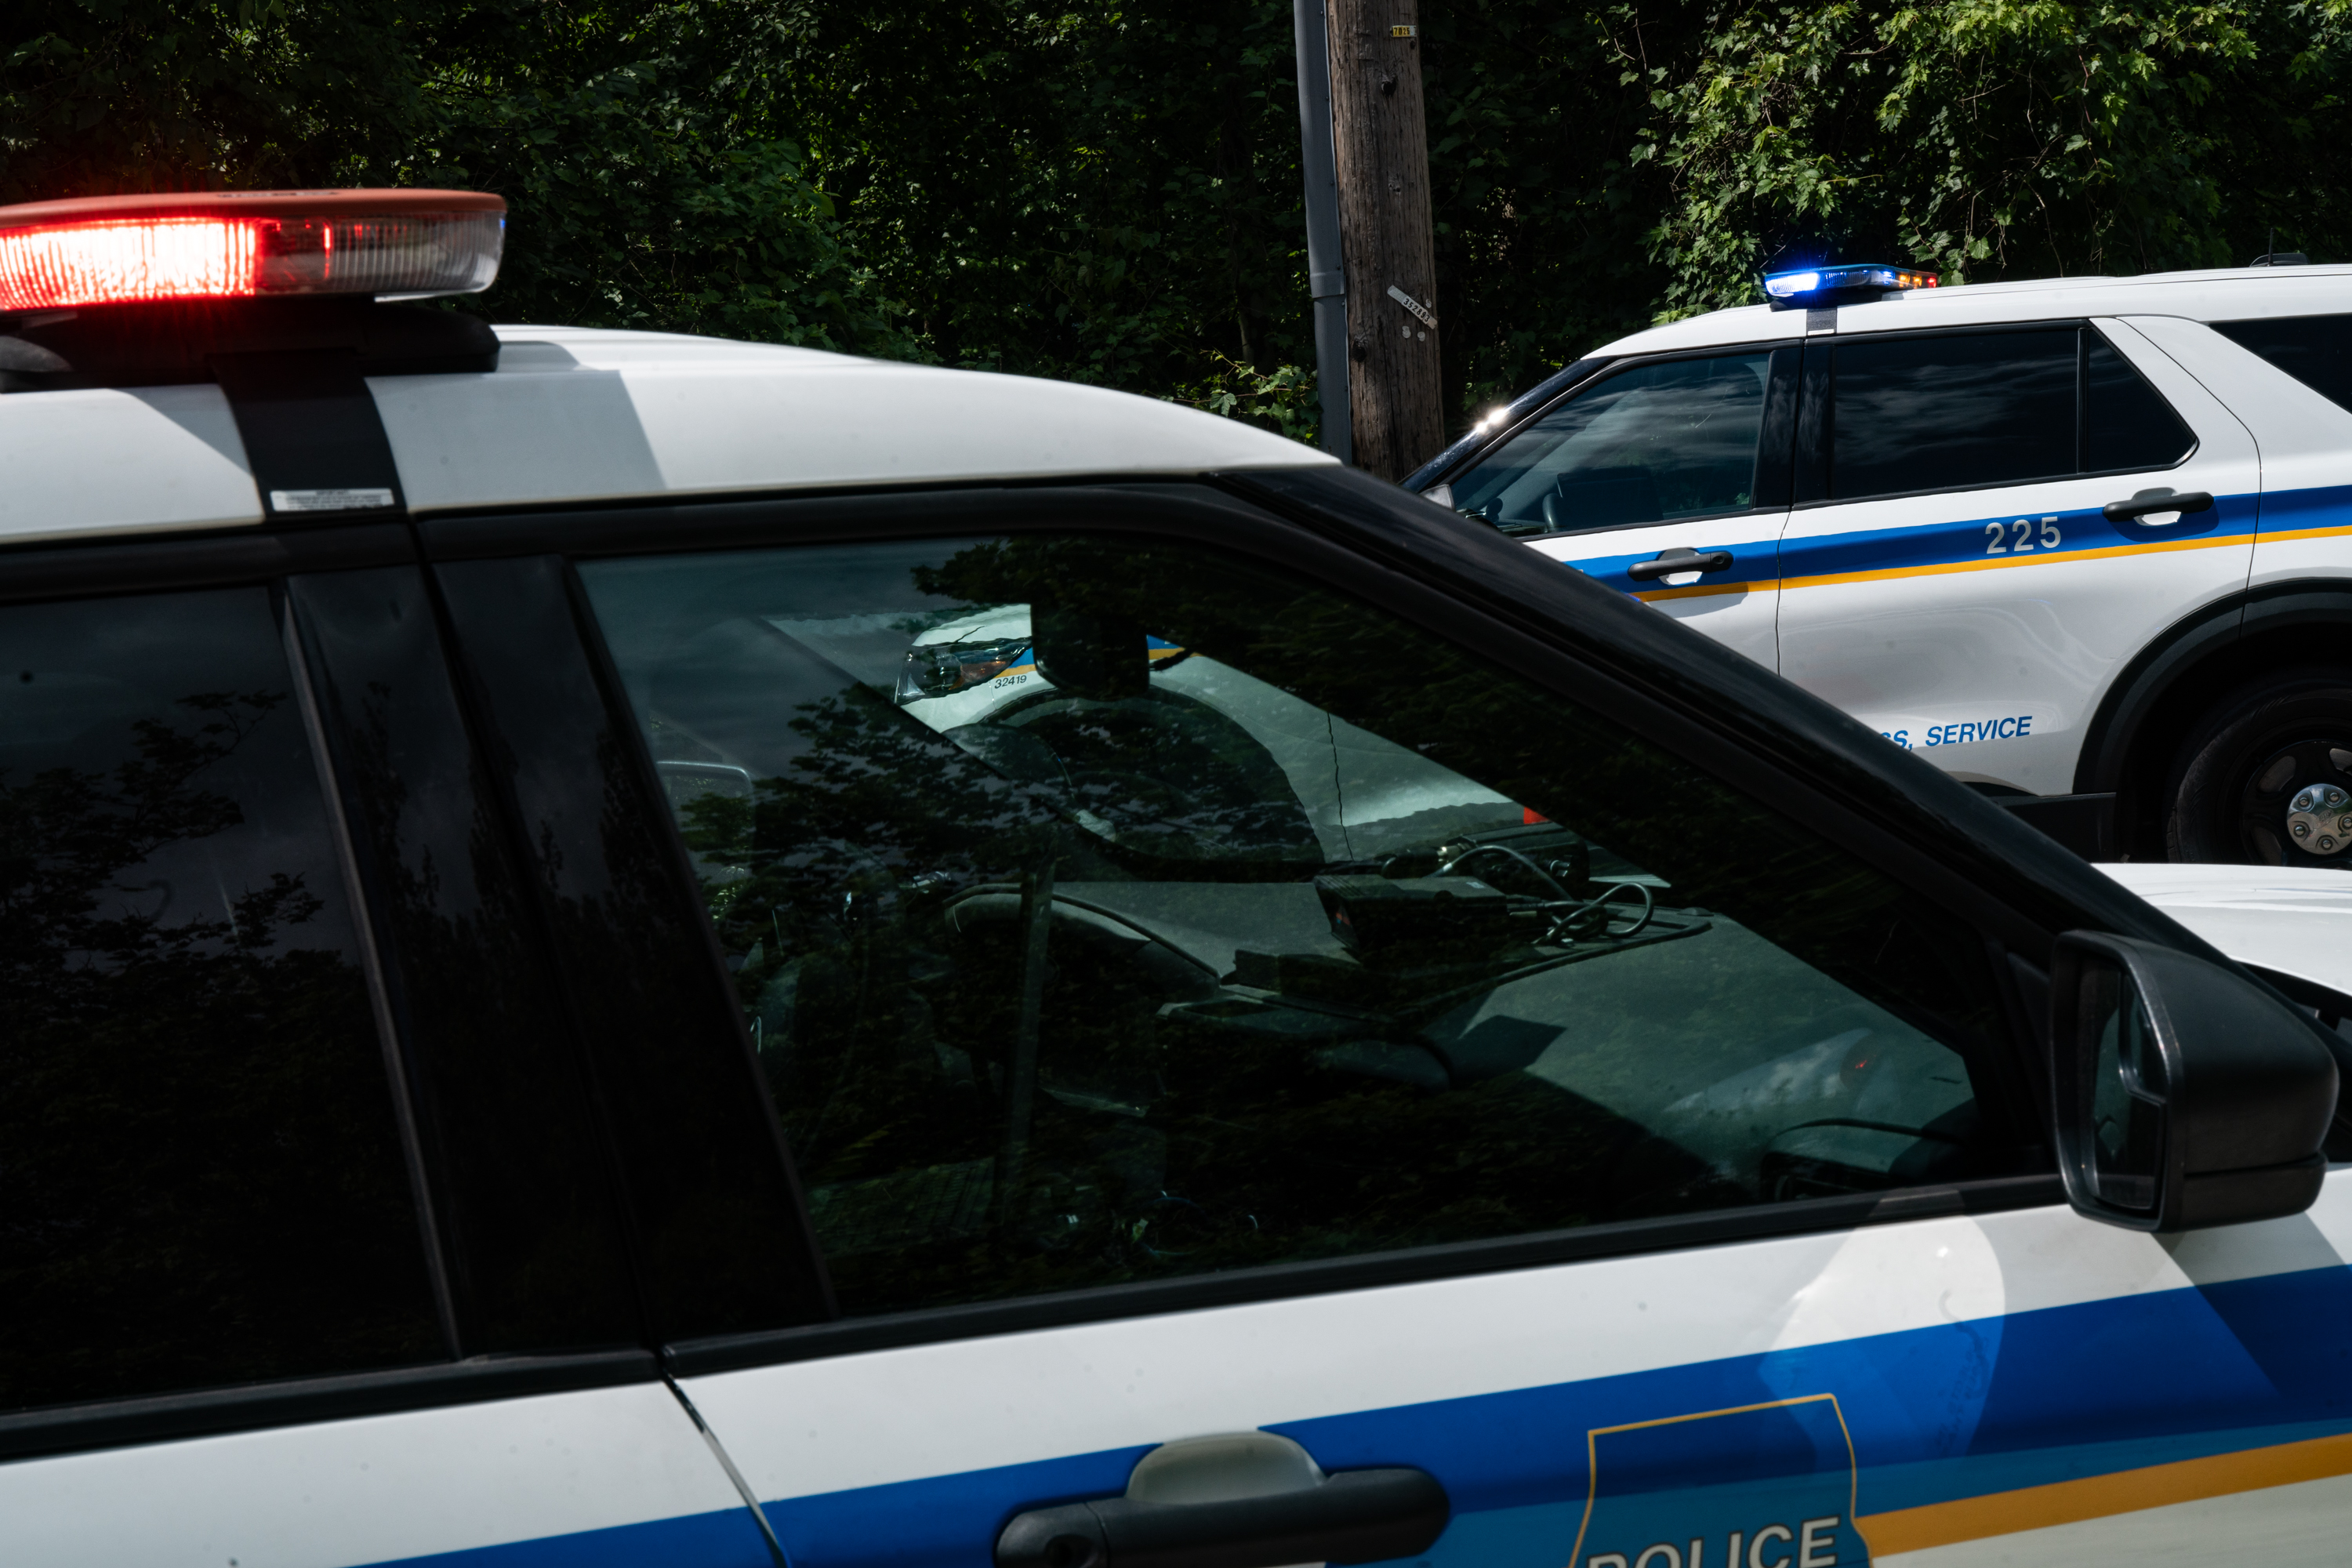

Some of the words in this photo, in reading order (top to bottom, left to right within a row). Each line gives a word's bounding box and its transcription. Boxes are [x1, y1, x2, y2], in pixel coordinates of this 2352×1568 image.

[1403, 298, 1430, 322] 352893
[1985, 516, 2061, 554] 225
[994, 675, 1027, 689] 32419
[1926, 716, 2033, 746] SERVICE
[1586, 1514, 1841, 1568] LICE
